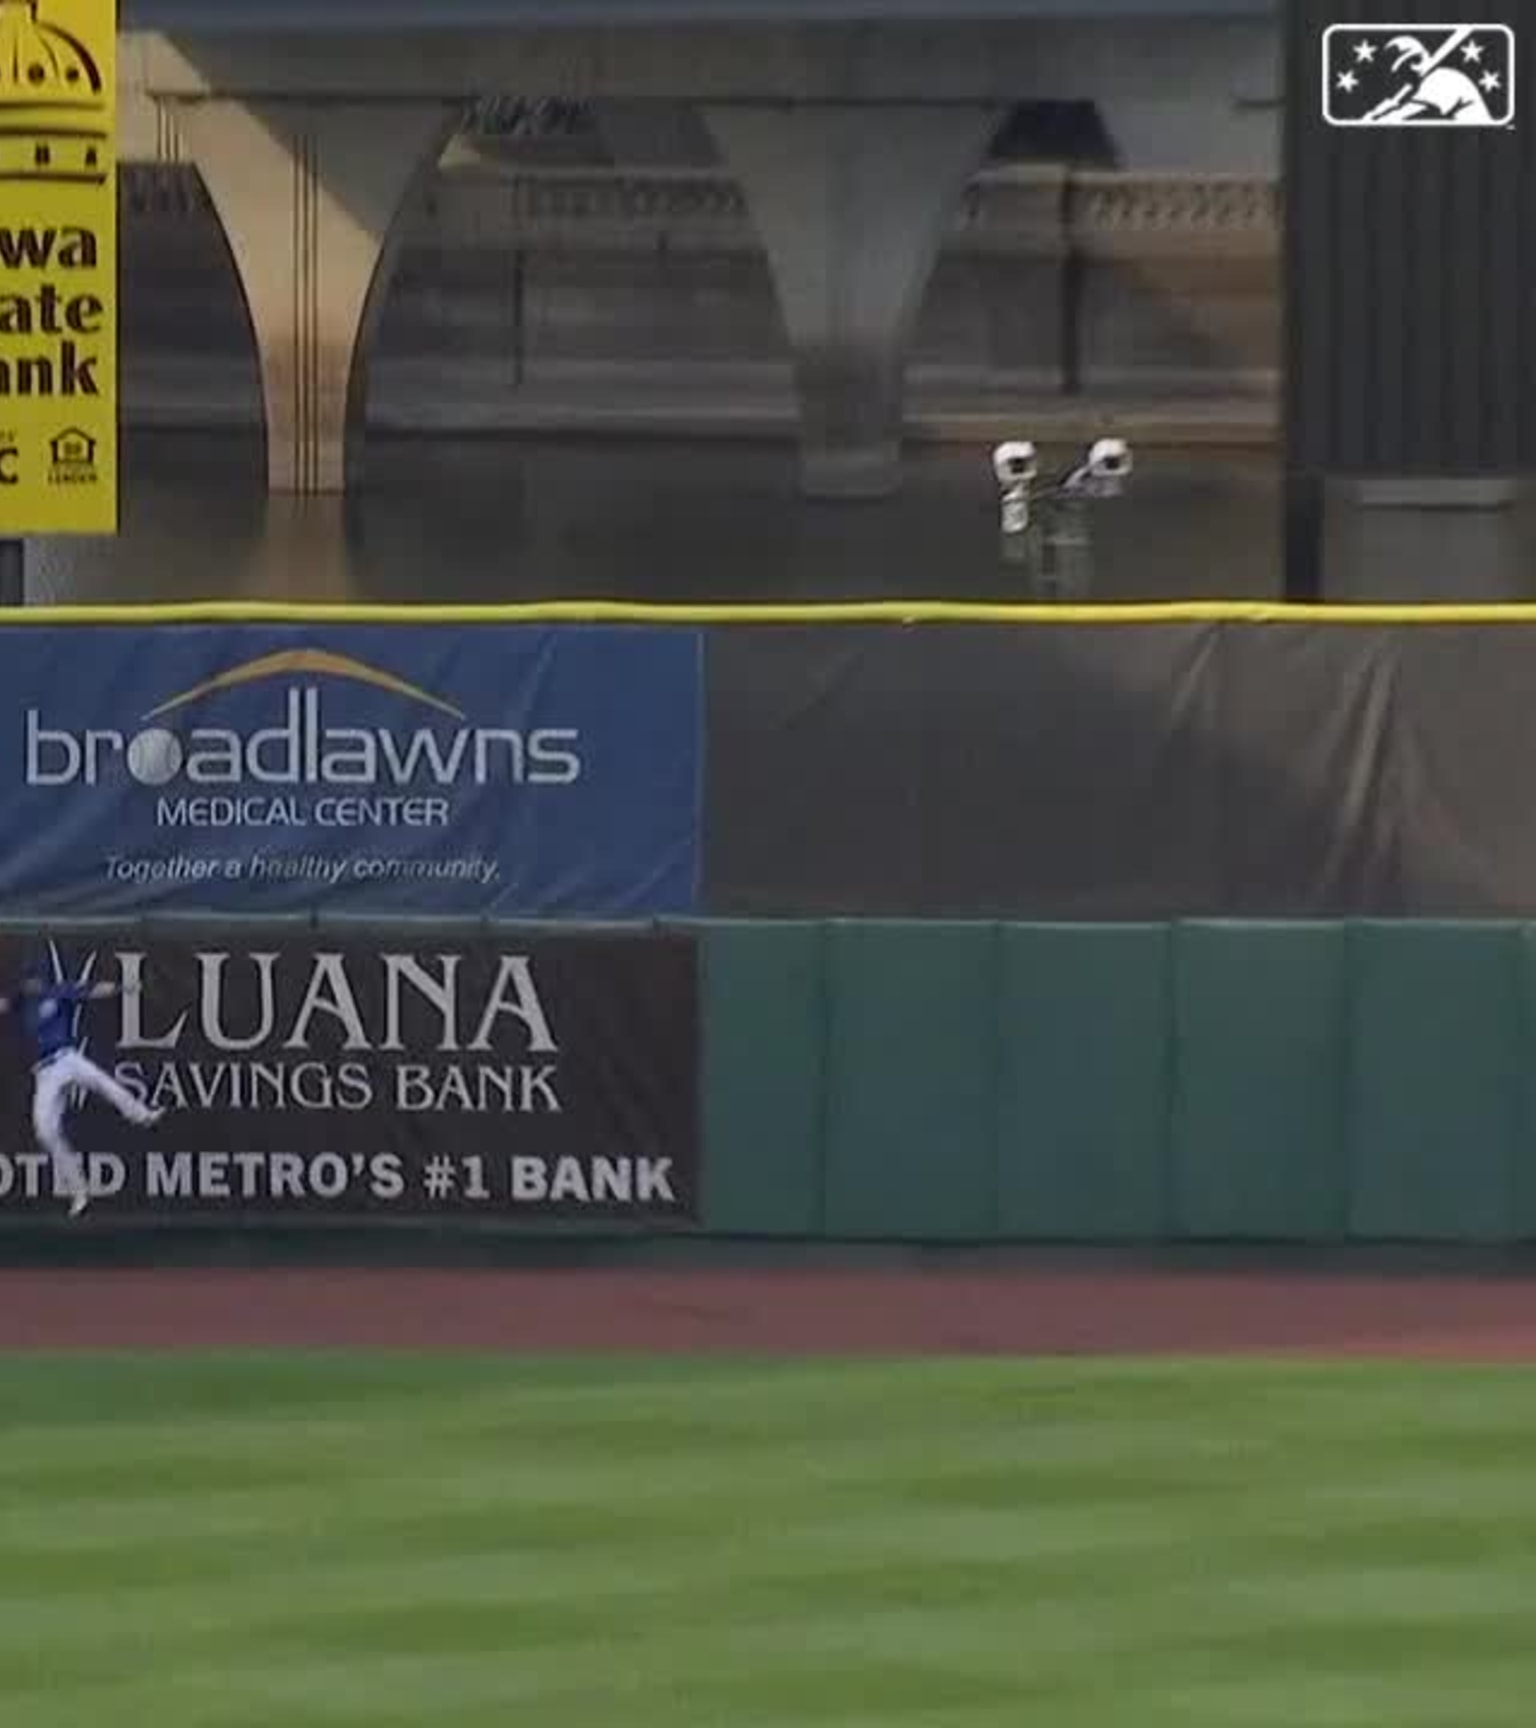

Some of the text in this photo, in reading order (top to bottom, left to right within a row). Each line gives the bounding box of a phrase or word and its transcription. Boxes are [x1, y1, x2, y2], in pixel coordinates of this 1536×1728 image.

[26, 686, 581, 786] broadlawns
[156, 795, 450, 827] MEDICAL CENTER
[107, 854, 501, 884] Together a healthy community.
[115, 950, 558, 1054] LUANA
[115, 1060, 563, 1113] SAVINGS BANK
[146, 1151, 406, 1199] METRO'S
[422, 1154, 489, 1199] #1
[511, 1154, 675, 1201] BANK
